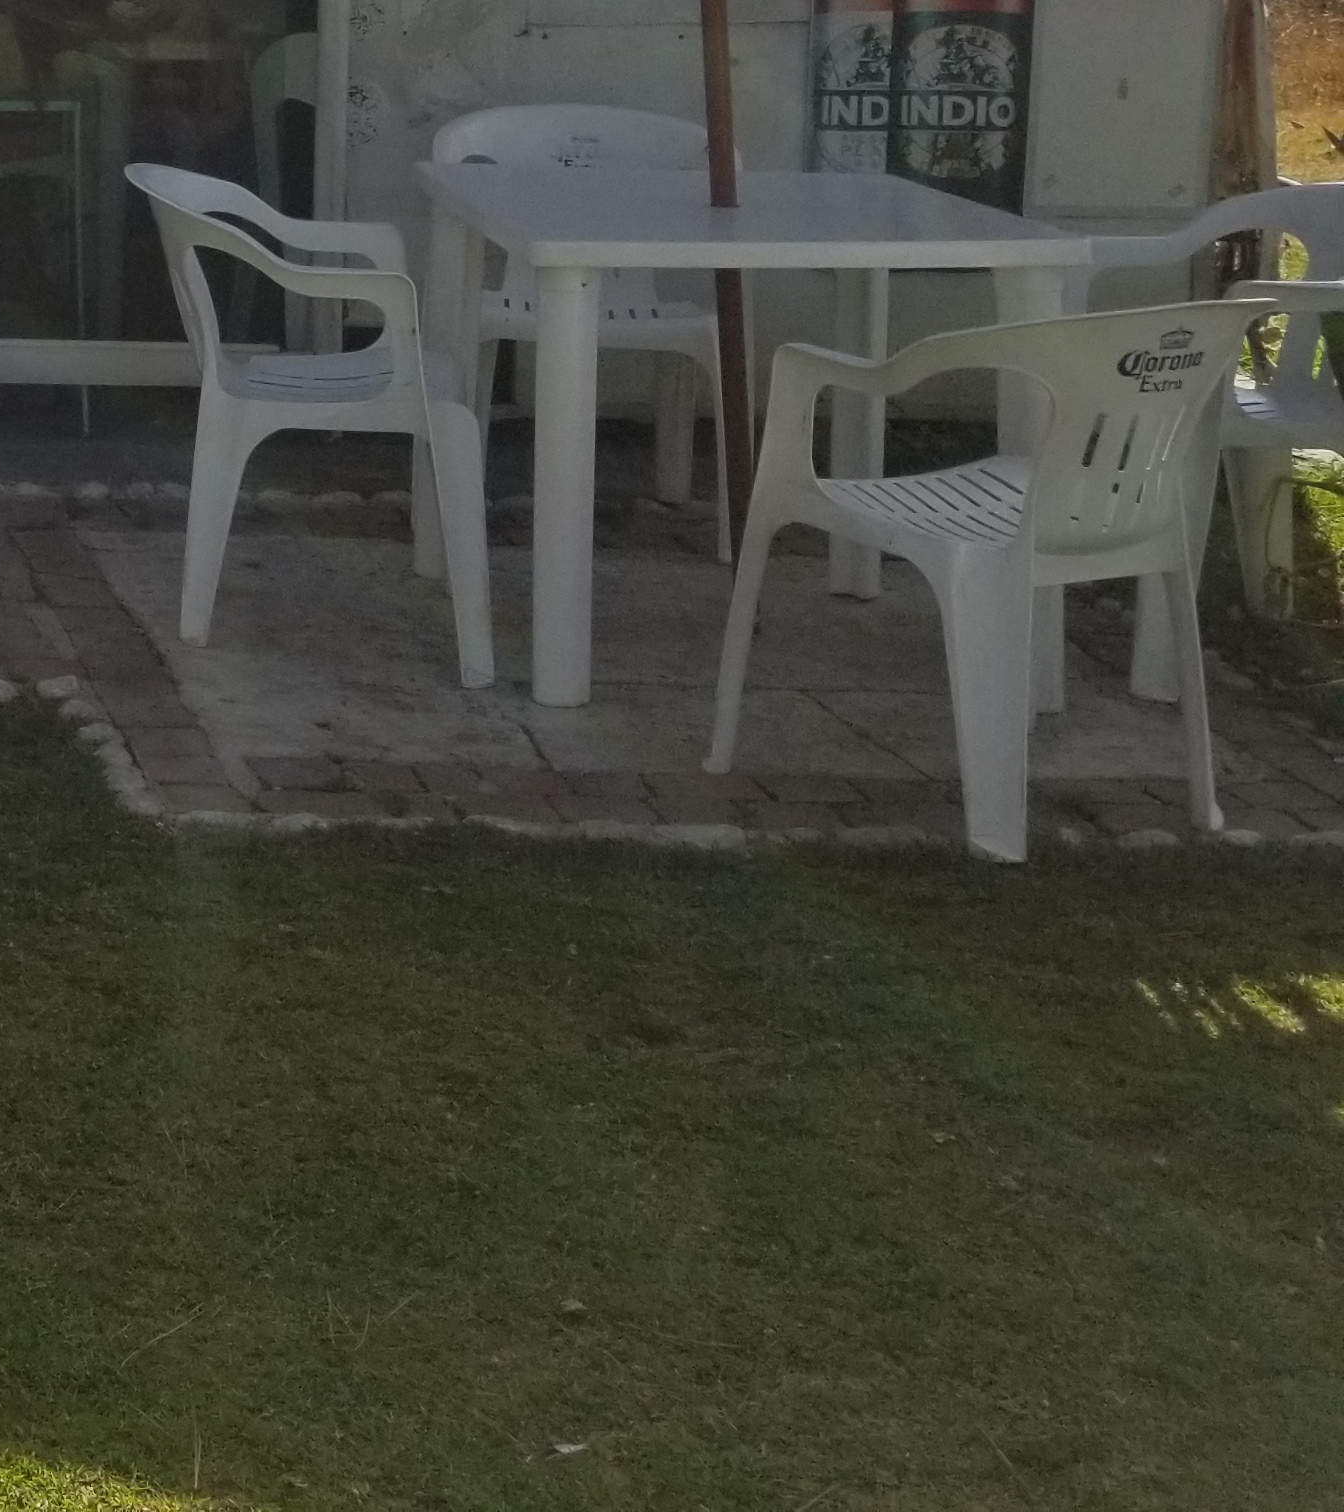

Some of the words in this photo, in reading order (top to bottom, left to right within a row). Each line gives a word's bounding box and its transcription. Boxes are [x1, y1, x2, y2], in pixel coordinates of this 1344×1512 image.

[821, 95, 890, 126] IND
[901, 95, 1016, 128] INDIO
[1118, 350, 1205, 379] Corona
[1140, 375, 1183, 392] Extra
